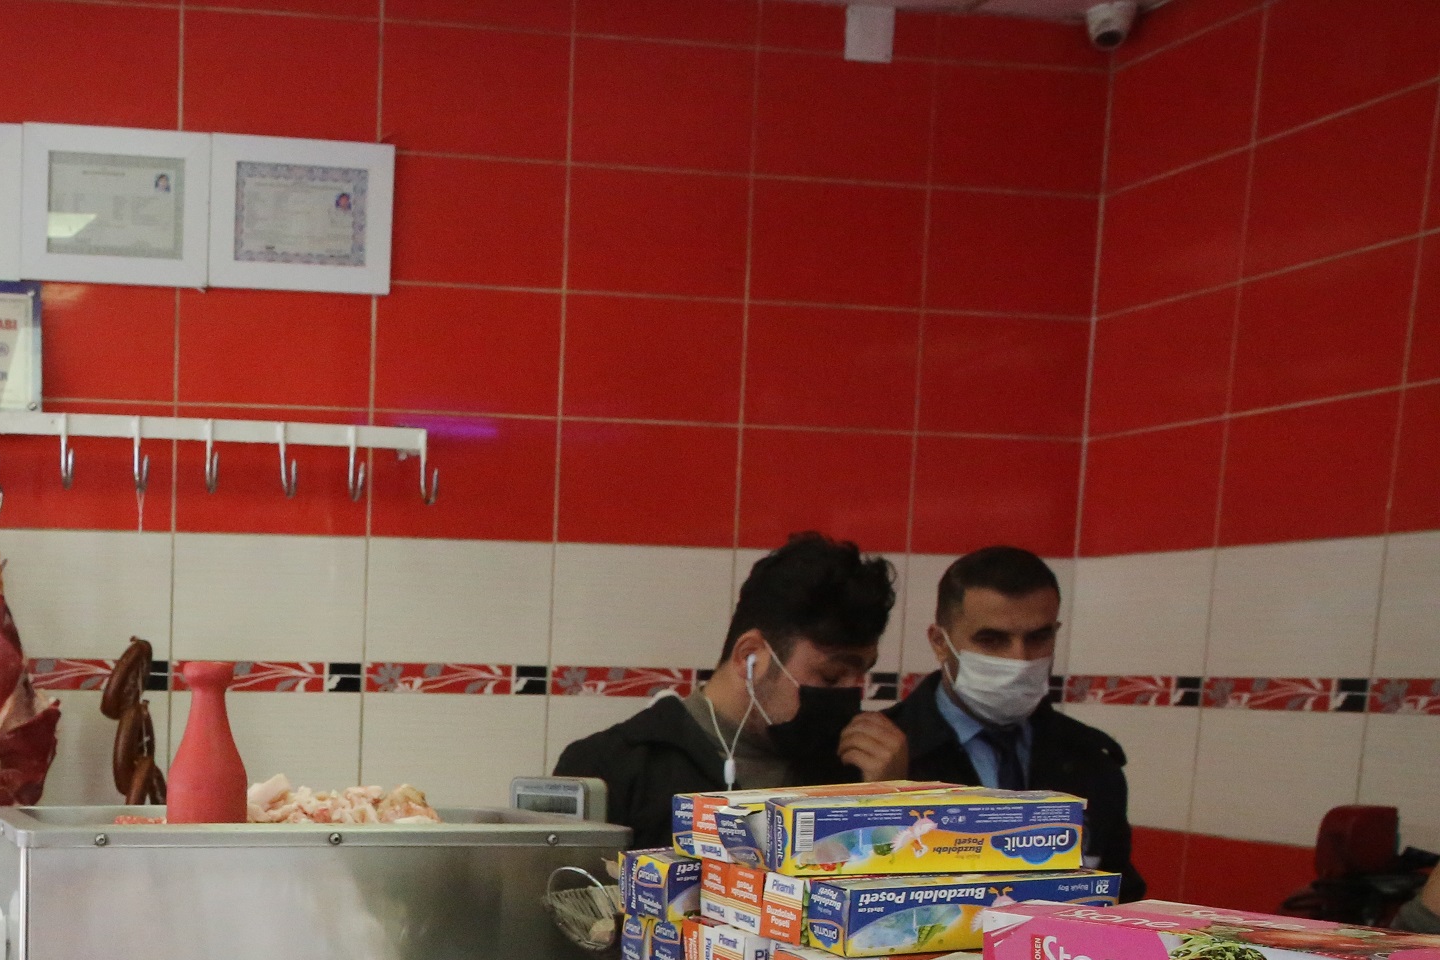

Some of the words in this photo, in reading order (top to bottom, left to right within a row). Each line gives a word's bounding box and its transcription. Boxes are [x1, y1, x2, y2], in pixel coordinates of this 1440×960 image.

[954, 837, 984, 847] Poşeti
[1003, 829, 1070, 851] piramit
[932, 845, 983, 854] Buzdolabı
[637, 867, 659, 882] piramit
[771, 879, 796, 895] Piramit
[909, 887, 987, 902] Buzdolabı
[1096, 885, 1109, 896] 20
[811, 893, 842, 911] Buzdolabı
[858, 891, 906, 907] Poşeti
[812, 924, 838, 940] piramit
